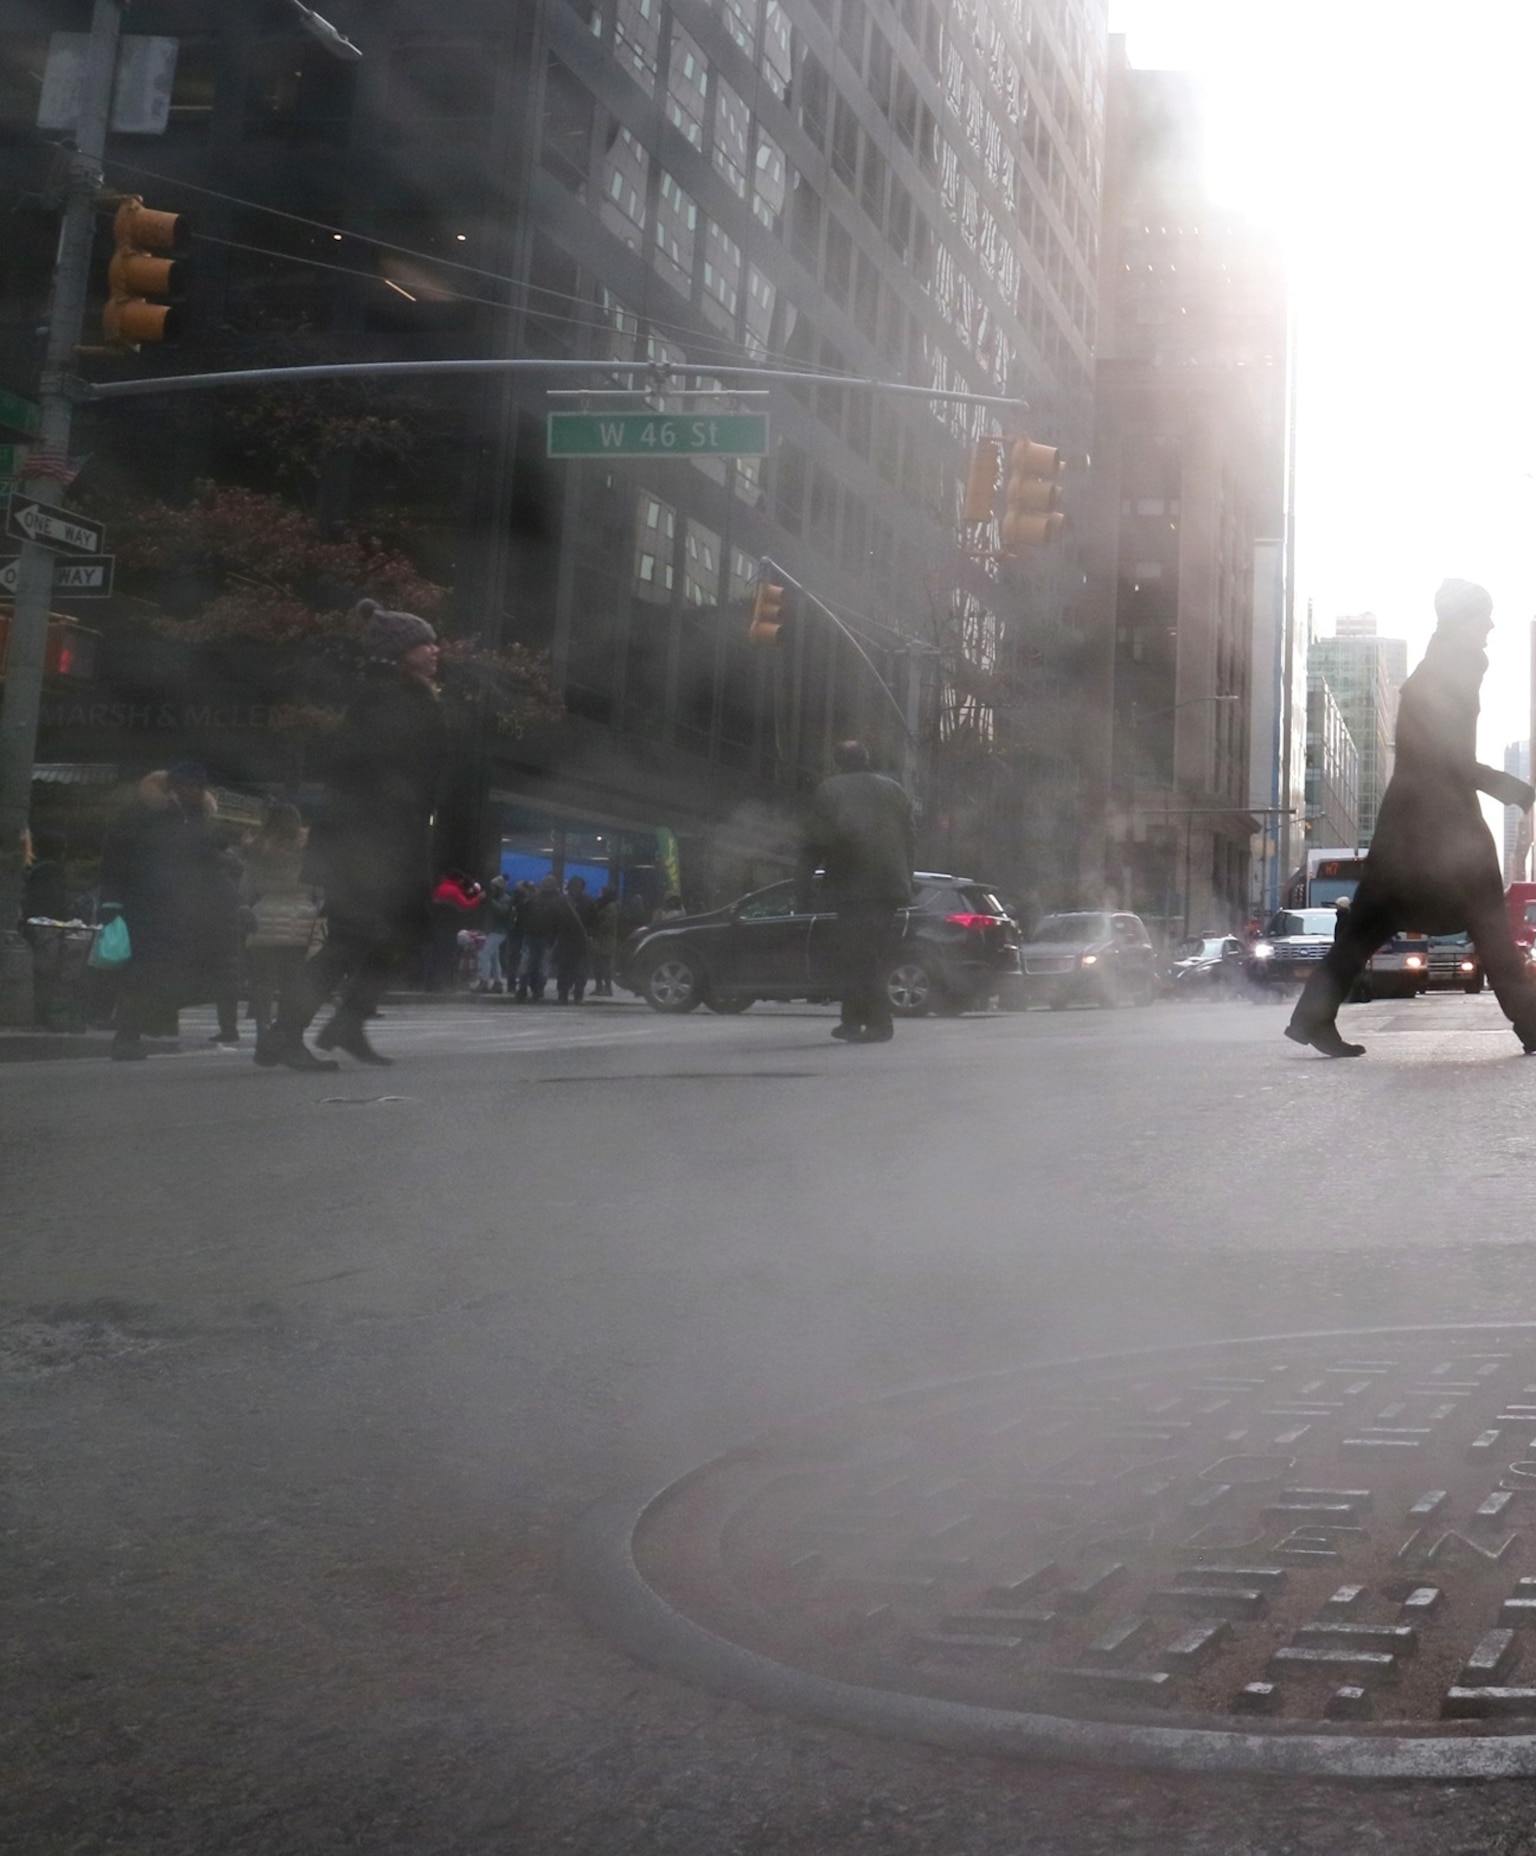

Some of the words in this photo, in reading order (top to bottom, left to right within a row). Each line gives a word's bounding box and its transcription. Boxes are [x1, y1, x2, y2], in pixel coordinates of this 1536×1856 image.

[600, 421, 625, 447] W
[640, 421, 676, 447] 46
[691, 421, 719, 447] St
[24, 511, 53, 536] ONE
[64, 524, 92, 546] WAY
[58, 568, 96, 585] WAY
[40, 704, 152, 728] MARSH
[155, 704, 177, 728] &
[1399, 1529, 1519, 1560] IN
